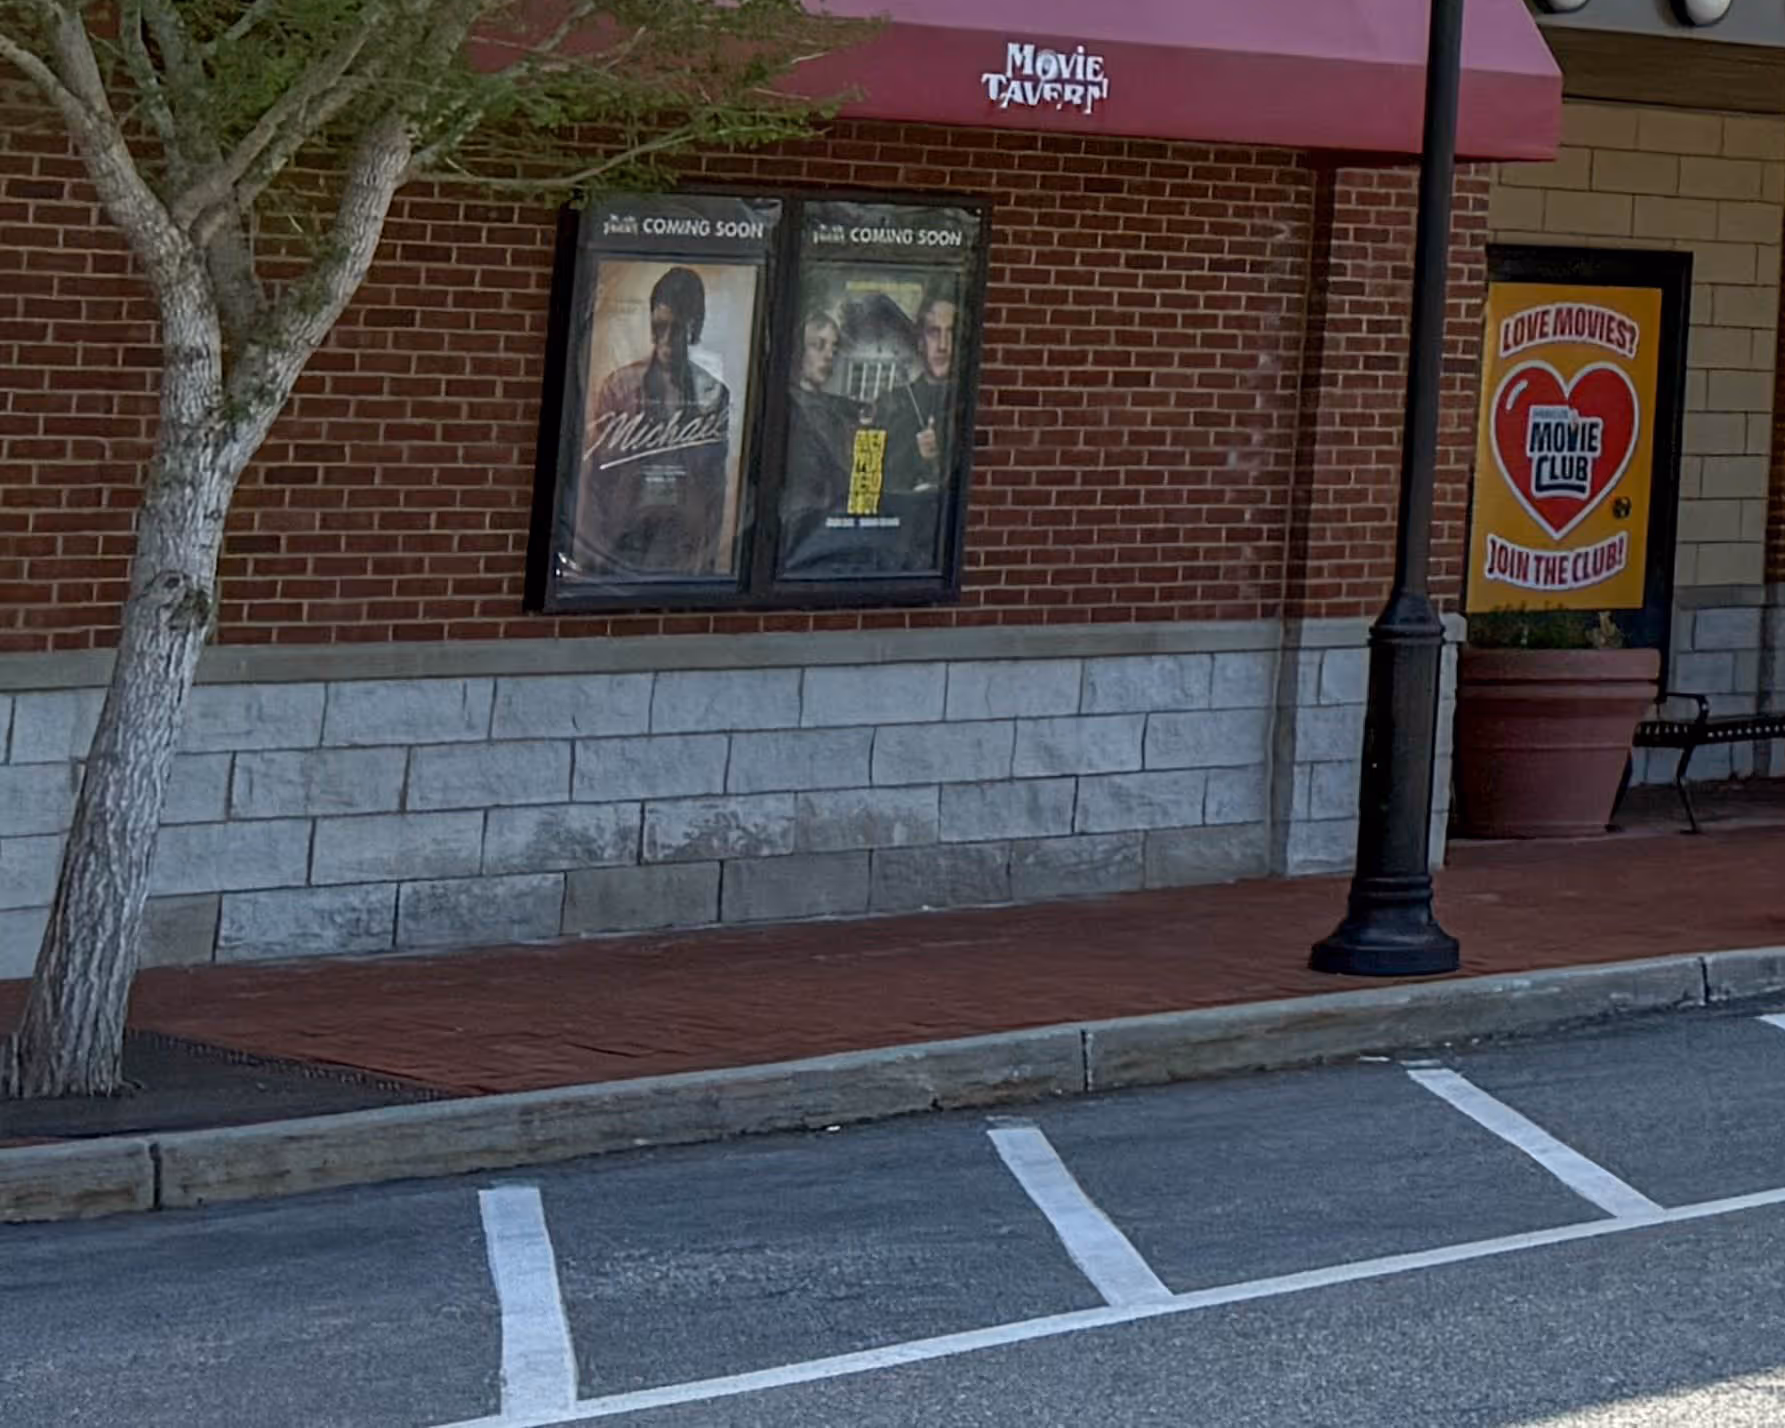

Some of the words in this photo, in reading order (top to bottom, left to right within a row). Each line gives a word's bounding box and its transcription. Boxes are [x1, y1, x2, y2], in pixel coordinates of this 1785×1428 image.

[642, 217, 711, 238] COMING
[715, 220, 764, 239] SOON
[850, 227, 913, 245] COMING
[916, 229, 962, 247] SOON
[1502, 309, 1551, 352] LOVE
[1553, 306, 1638, 355] MOVIES?
[583, 408, 729, 462] Michael
[1529, 421, 1601, 453] MOVIE
[1535, 454, 1588, 494] CLUB
[1488, 537, 1530, 584] JOIN
[1534, 553, 1570, 586] THE
[1572, 535, 1625, 582] CLUB!
